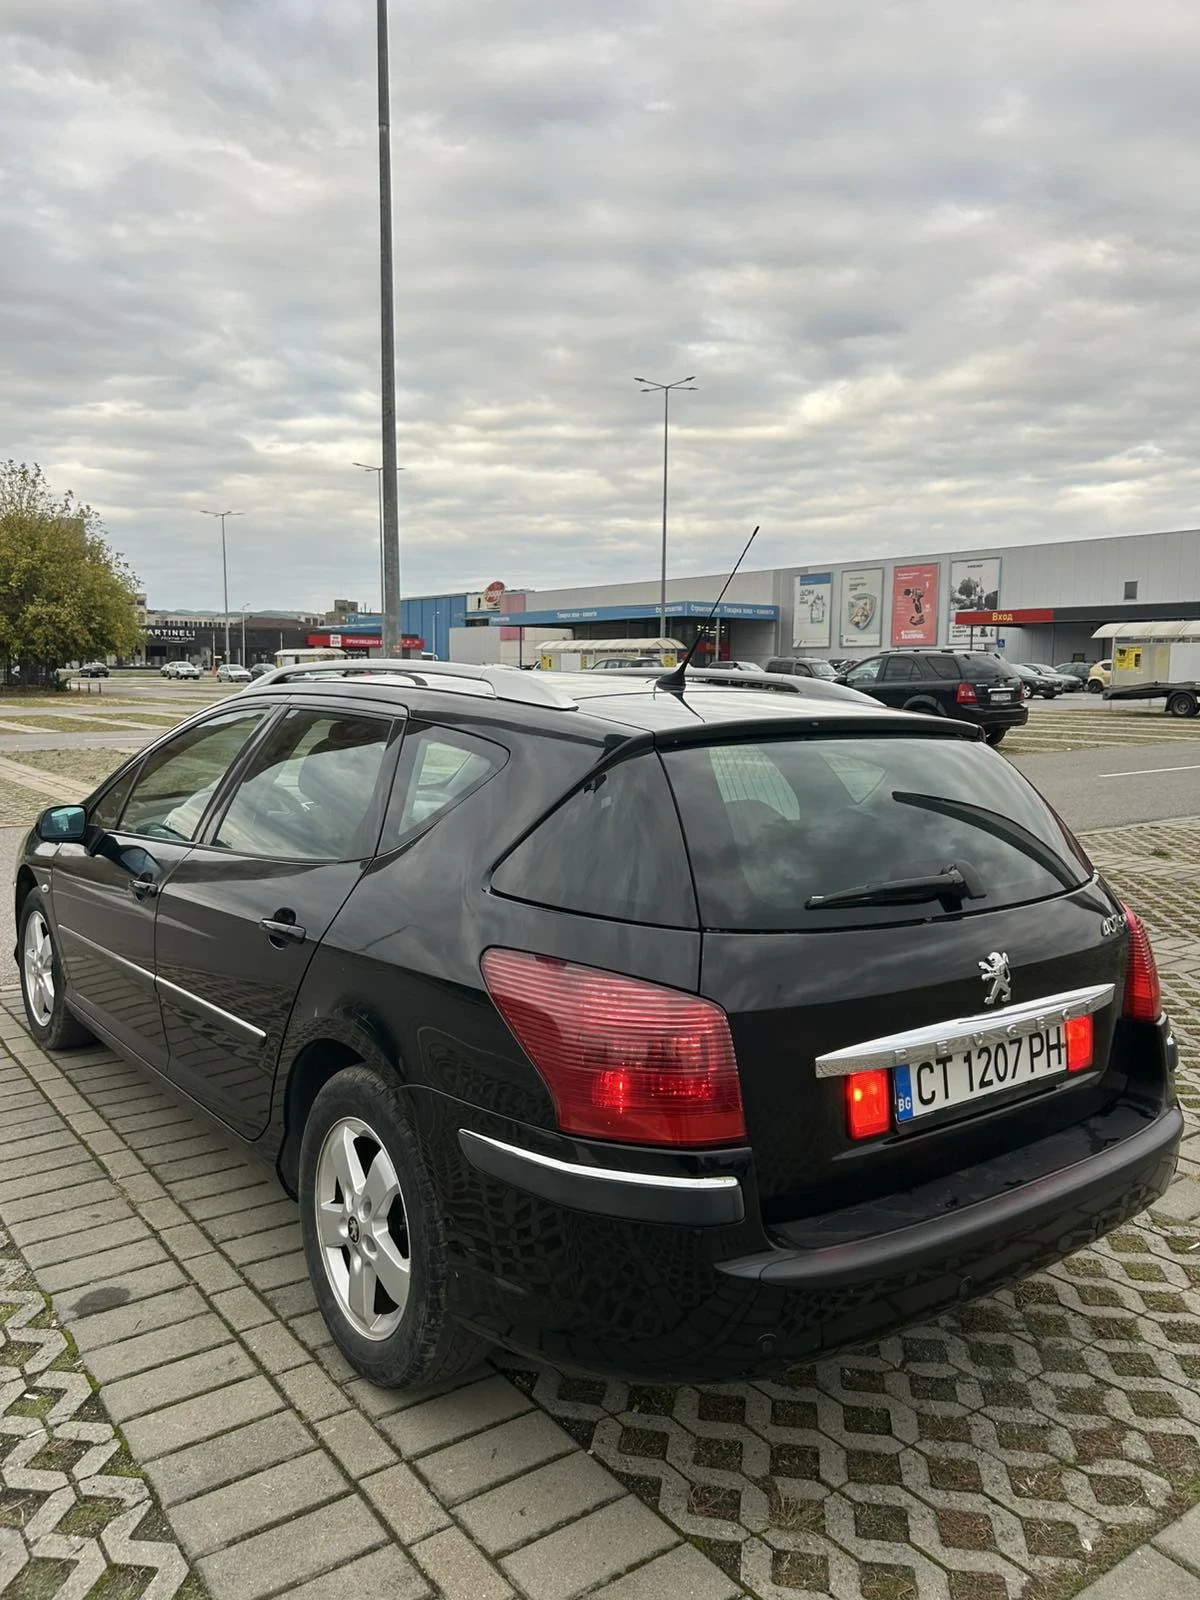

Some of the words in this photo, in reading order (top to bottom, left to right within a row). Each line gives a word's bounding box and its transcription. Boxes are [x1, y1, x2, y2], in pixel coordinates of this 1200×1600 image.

[992, 612, 1013, 622] Вход
[916, 1054, 953, 1106] CT
[963, 1037, 1024, 1093] 1207
[1028, 1026, 1063, 1074] PH
[898, 1096, 912, 1112] BG
